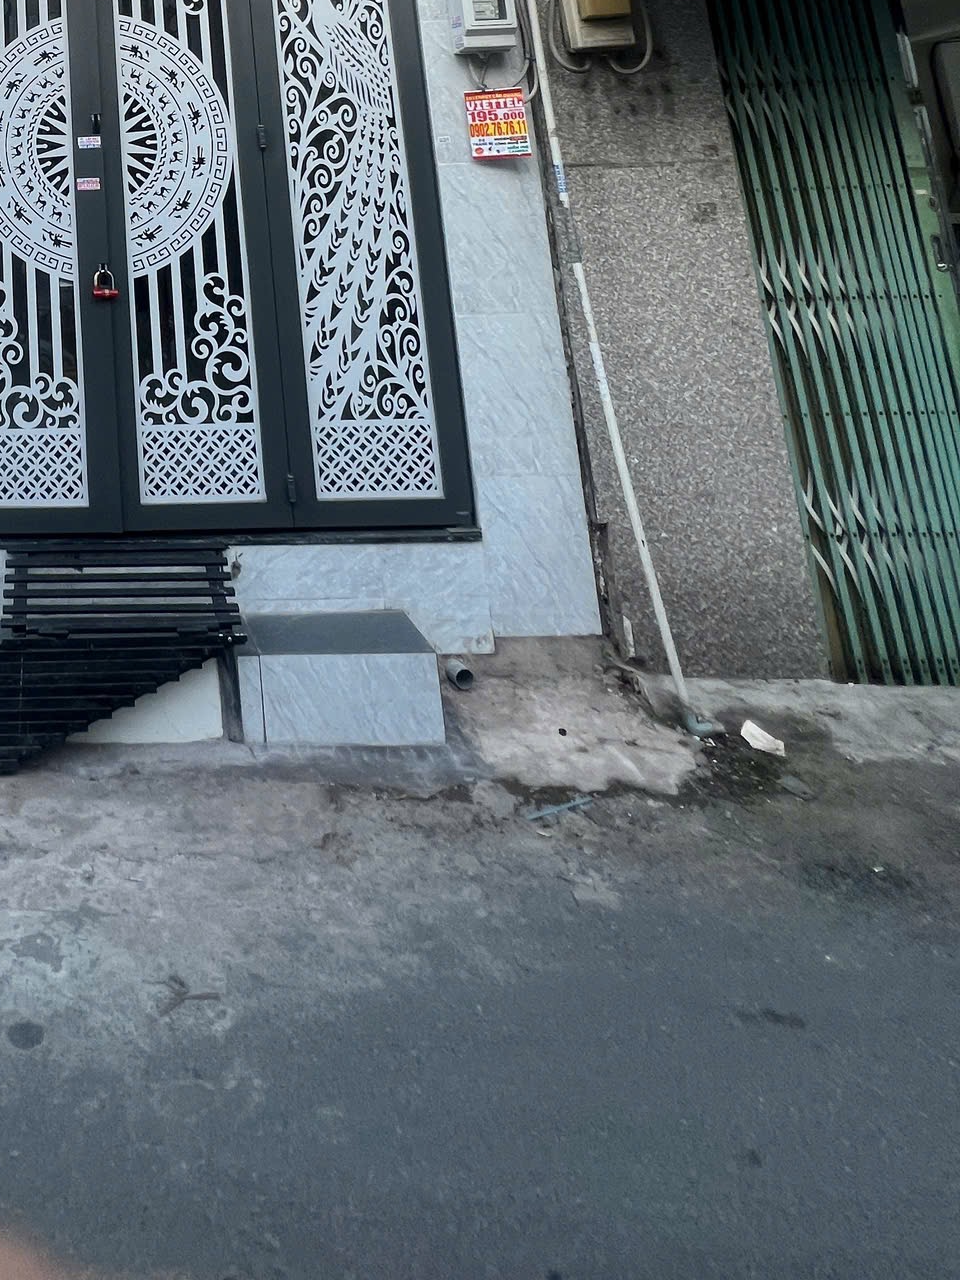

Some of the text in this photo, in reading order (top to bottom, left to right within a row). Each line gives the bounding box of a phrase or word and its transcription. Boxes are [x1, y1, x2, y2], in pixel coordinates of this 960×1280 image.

[466, 97, 523, 110] VIETTEL
[468, 110, 525, 122] 195.000
[470, 120, 527, 137] 0902.76.76.11
